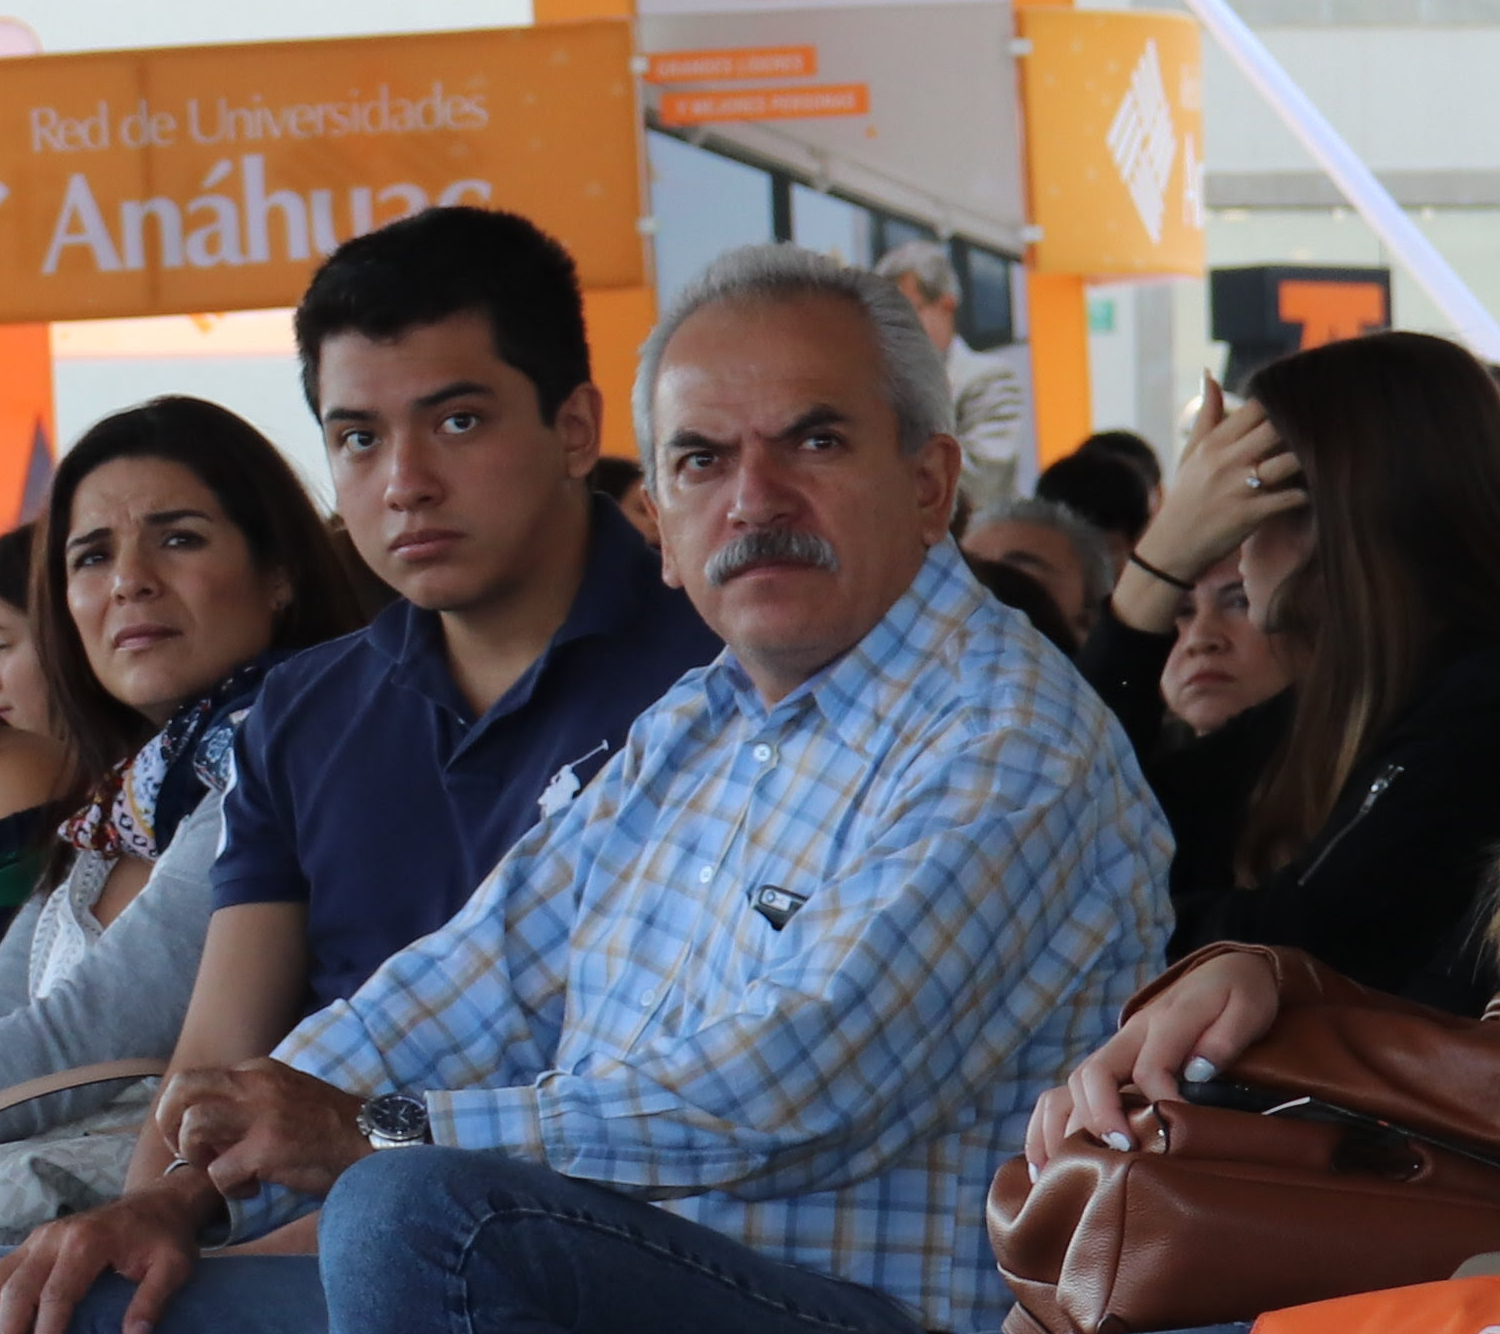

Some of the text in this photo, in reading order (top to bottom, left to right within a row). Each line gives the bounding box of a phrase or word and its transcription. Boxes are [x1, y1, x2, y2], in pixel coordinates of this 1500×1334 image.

[30, 81, 490, 153] Red de Universidades
